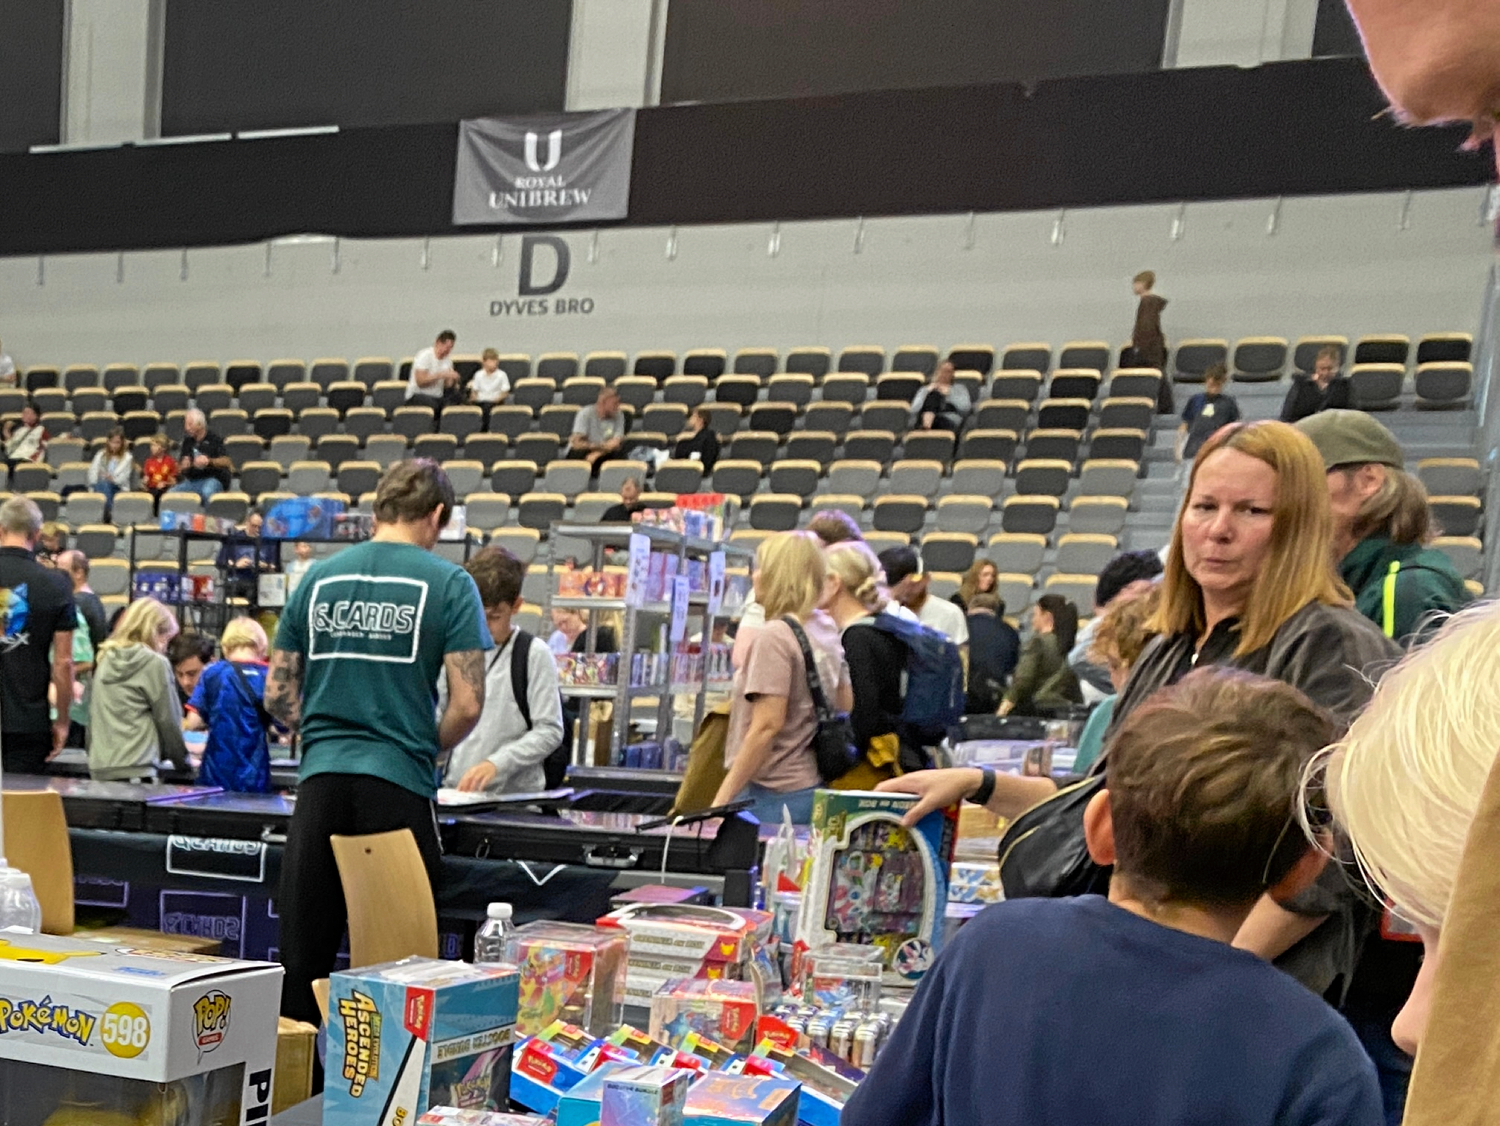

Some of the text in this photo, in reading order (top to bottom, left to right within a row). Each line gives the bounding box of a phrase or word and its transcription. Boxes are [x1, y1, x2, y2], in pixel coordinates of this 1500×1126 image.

[489, 188, 592, 209] UNIBREW
[514, 174, 566, 189] ROYAL
[518, 233, 571, 297] D
[490, 298, 595, 316] DYVES BRO
[103, 1013, 147, 1048] 598
[193, 995, 231, 1034] POP!
[338, 998, 359, 1080] HEROES
[349, 989, 377, 1098] ASCENDED
